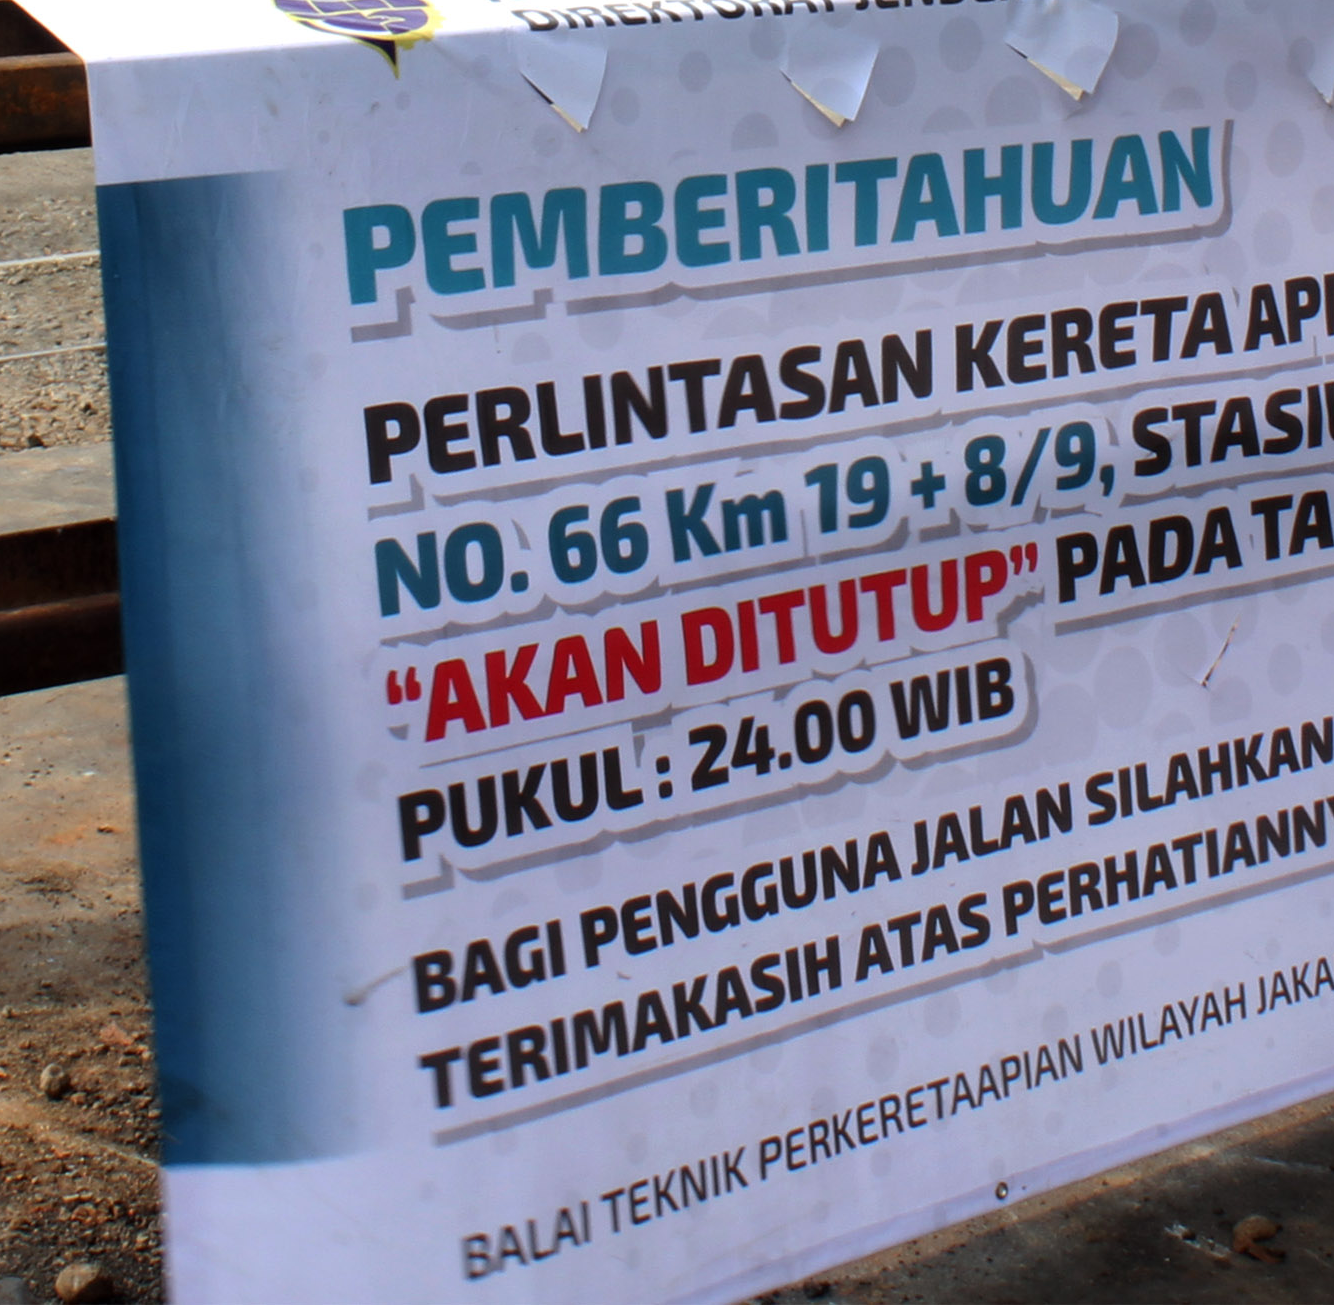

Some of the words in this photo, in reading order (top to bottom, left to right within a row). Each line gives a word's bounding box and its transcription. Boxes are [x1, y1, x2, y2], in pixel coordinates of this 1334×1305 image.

[342, 126, 1213, 305] PEMBERITAHUAN
[363, 329, 933, 485] PERLINTASAN
[955, 292, 1234, 393] KERETA
[374, 522, 529, 618] NO.
[548, 496, 649, 585] 66
[665, 483, 789, 564] Km
[1055, 494, 1244, 604] PADA
[397, 746, 644, 863] PUKUL
[688, 689, 876, 792] 24.00
[889, 657, 1015, 741] WIB
[412, 919, 566, 1015] BAGI
[580, 831, 902, 969] PENGGUNA
[911, 782, 1073, 877] JALAN
[1085, 716, 1334, 827] SILAHKAN
[419, 935, 842, 1110] TERIMAKASIH
[855, 892, 991, 982] ATAS
[463, 1200, 591, 1282] BALAI
[601, 1147, 748, 1233] TEKNIK
[759, 1035, 1083, 1181] PERKERETAAPIAN
[1091, 983, 1247, 1066] WILAYAH
